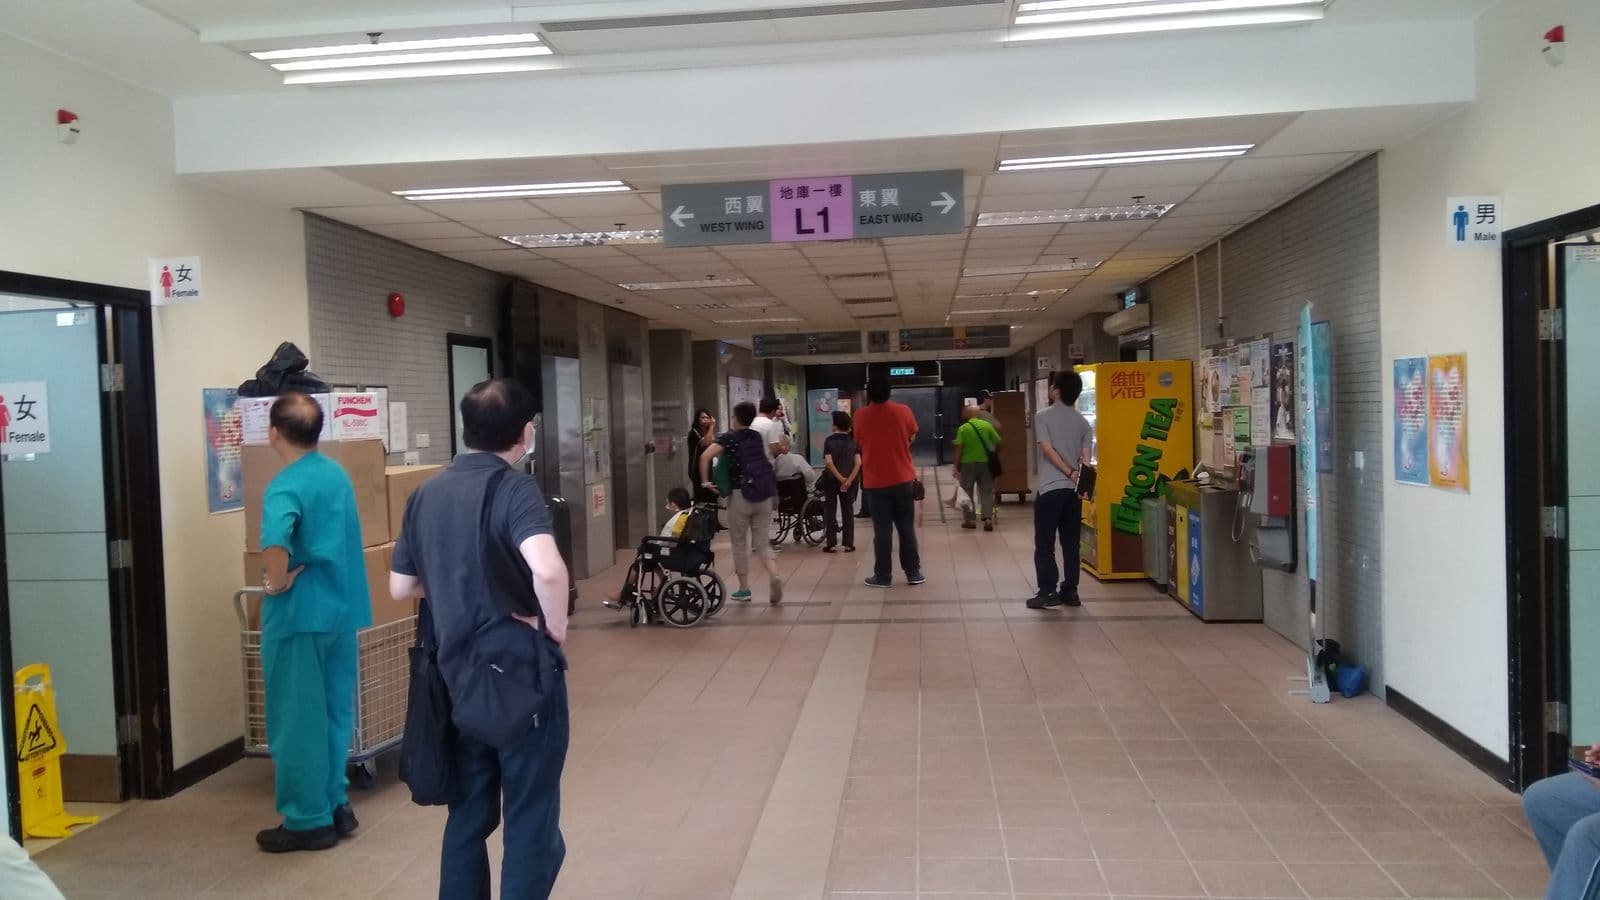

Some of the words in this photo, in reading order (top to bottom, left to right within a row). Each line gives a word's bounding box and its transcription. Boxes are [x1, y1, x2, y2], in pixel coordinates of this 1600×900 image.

[780, 183, 842, 200] 地庫一樓
[859, 188, 899, 208] 東翼
[724, 195, 764, 215] 西翼
[795, 207, 830, 234] L1
[860, 214, 892, 225] EAST
[894, 212, 923, 224] WING
[1476, 204, 1496, 224] 男
[700, 222, 732, 233] WEST
[734, 220, 765, 231] WING
[1474, 232, 1496, 241] Male
[175, 264, 192, 282] 女
[172, 288, 199, 298] Female
[1111, 370, 1145, 387] 維他
[14, 394, 37, 421] 女
[337, 396, 372, 405] FUNCHEM
[1140, 398, 1178, 441] TEA
[9, 430, 46, 443] Female
